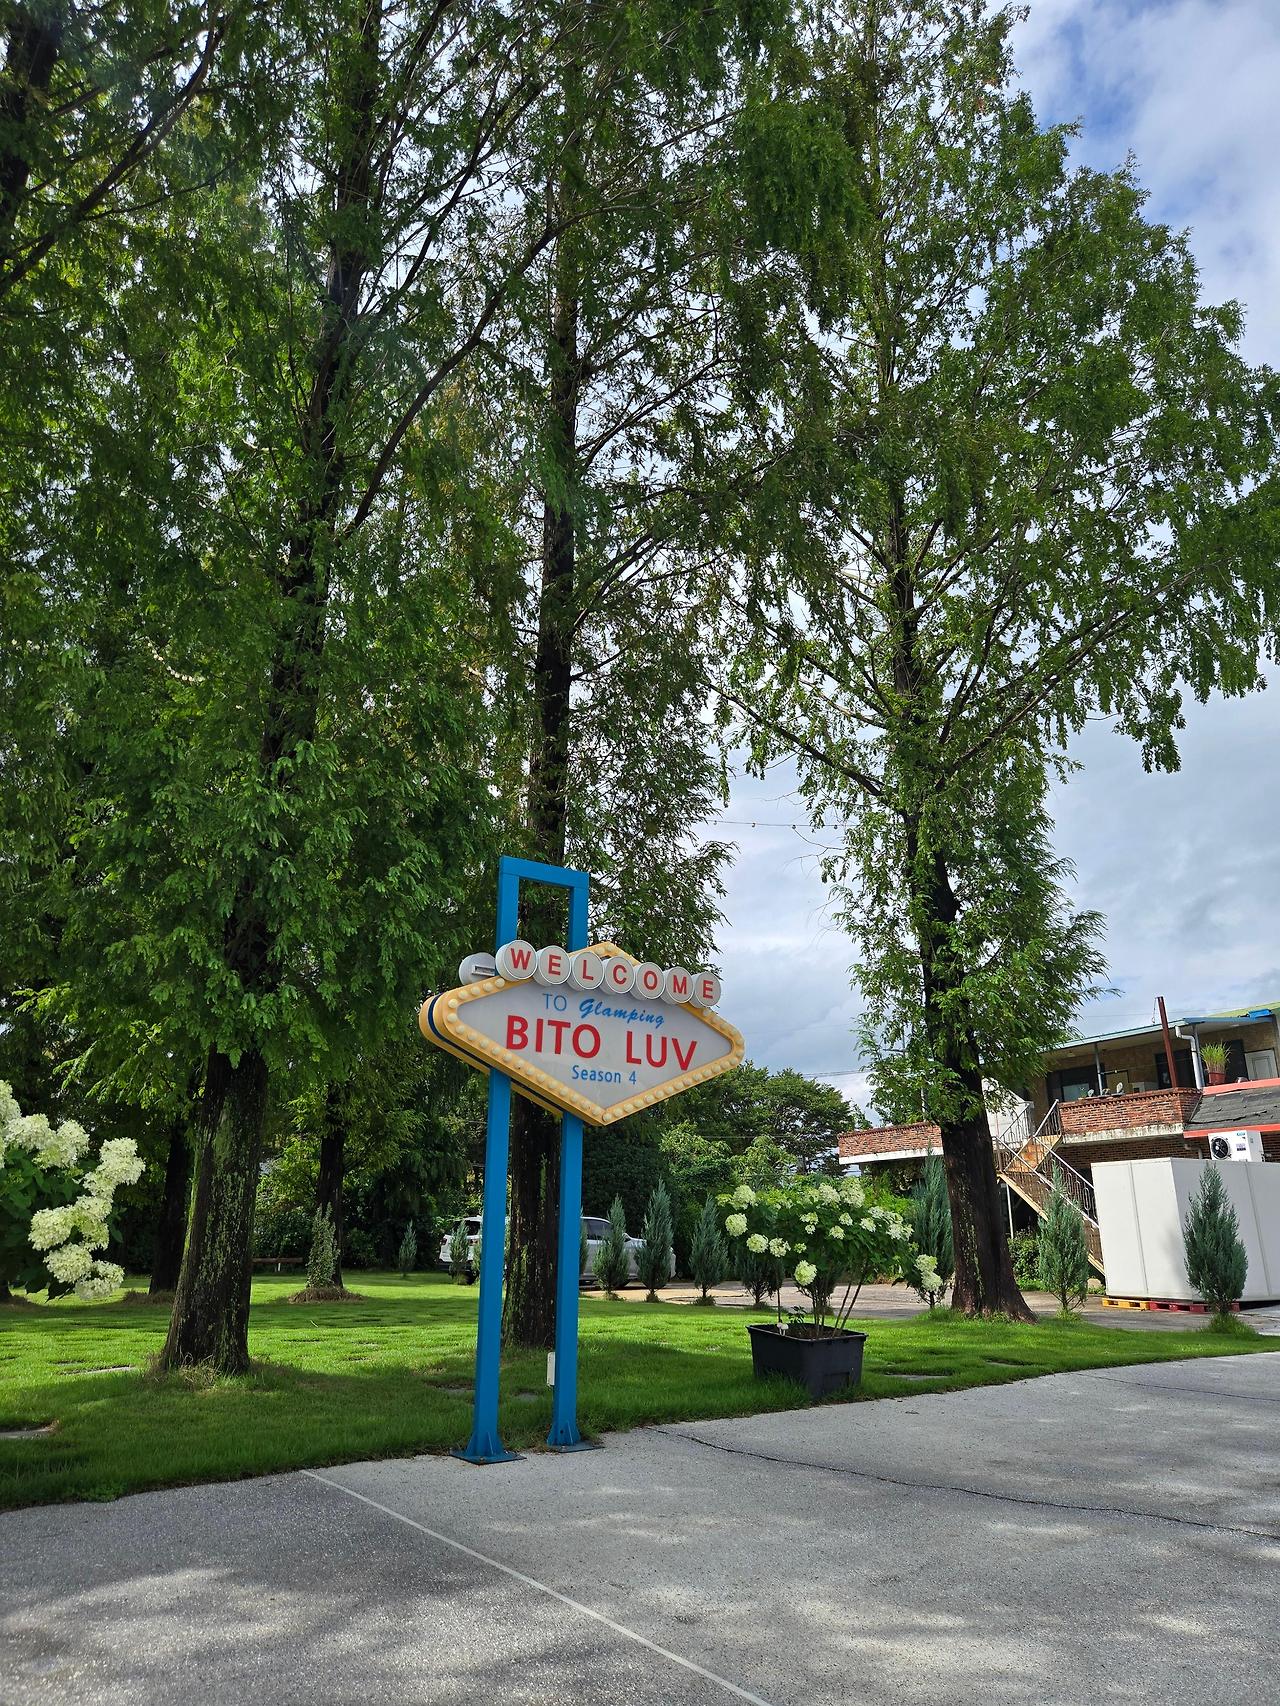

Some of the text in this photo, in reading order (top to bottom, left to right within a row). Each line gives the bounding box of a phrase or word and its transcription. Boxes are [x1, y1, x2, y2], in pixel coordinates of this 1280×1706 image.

[510, 947, 714, 1000] WELCOME
[542, 992, 665, 1028] TO Glamping
[506, 1015, 697, 1071] BITO LUV
[572, 1065, 637, 1085] Season 4
